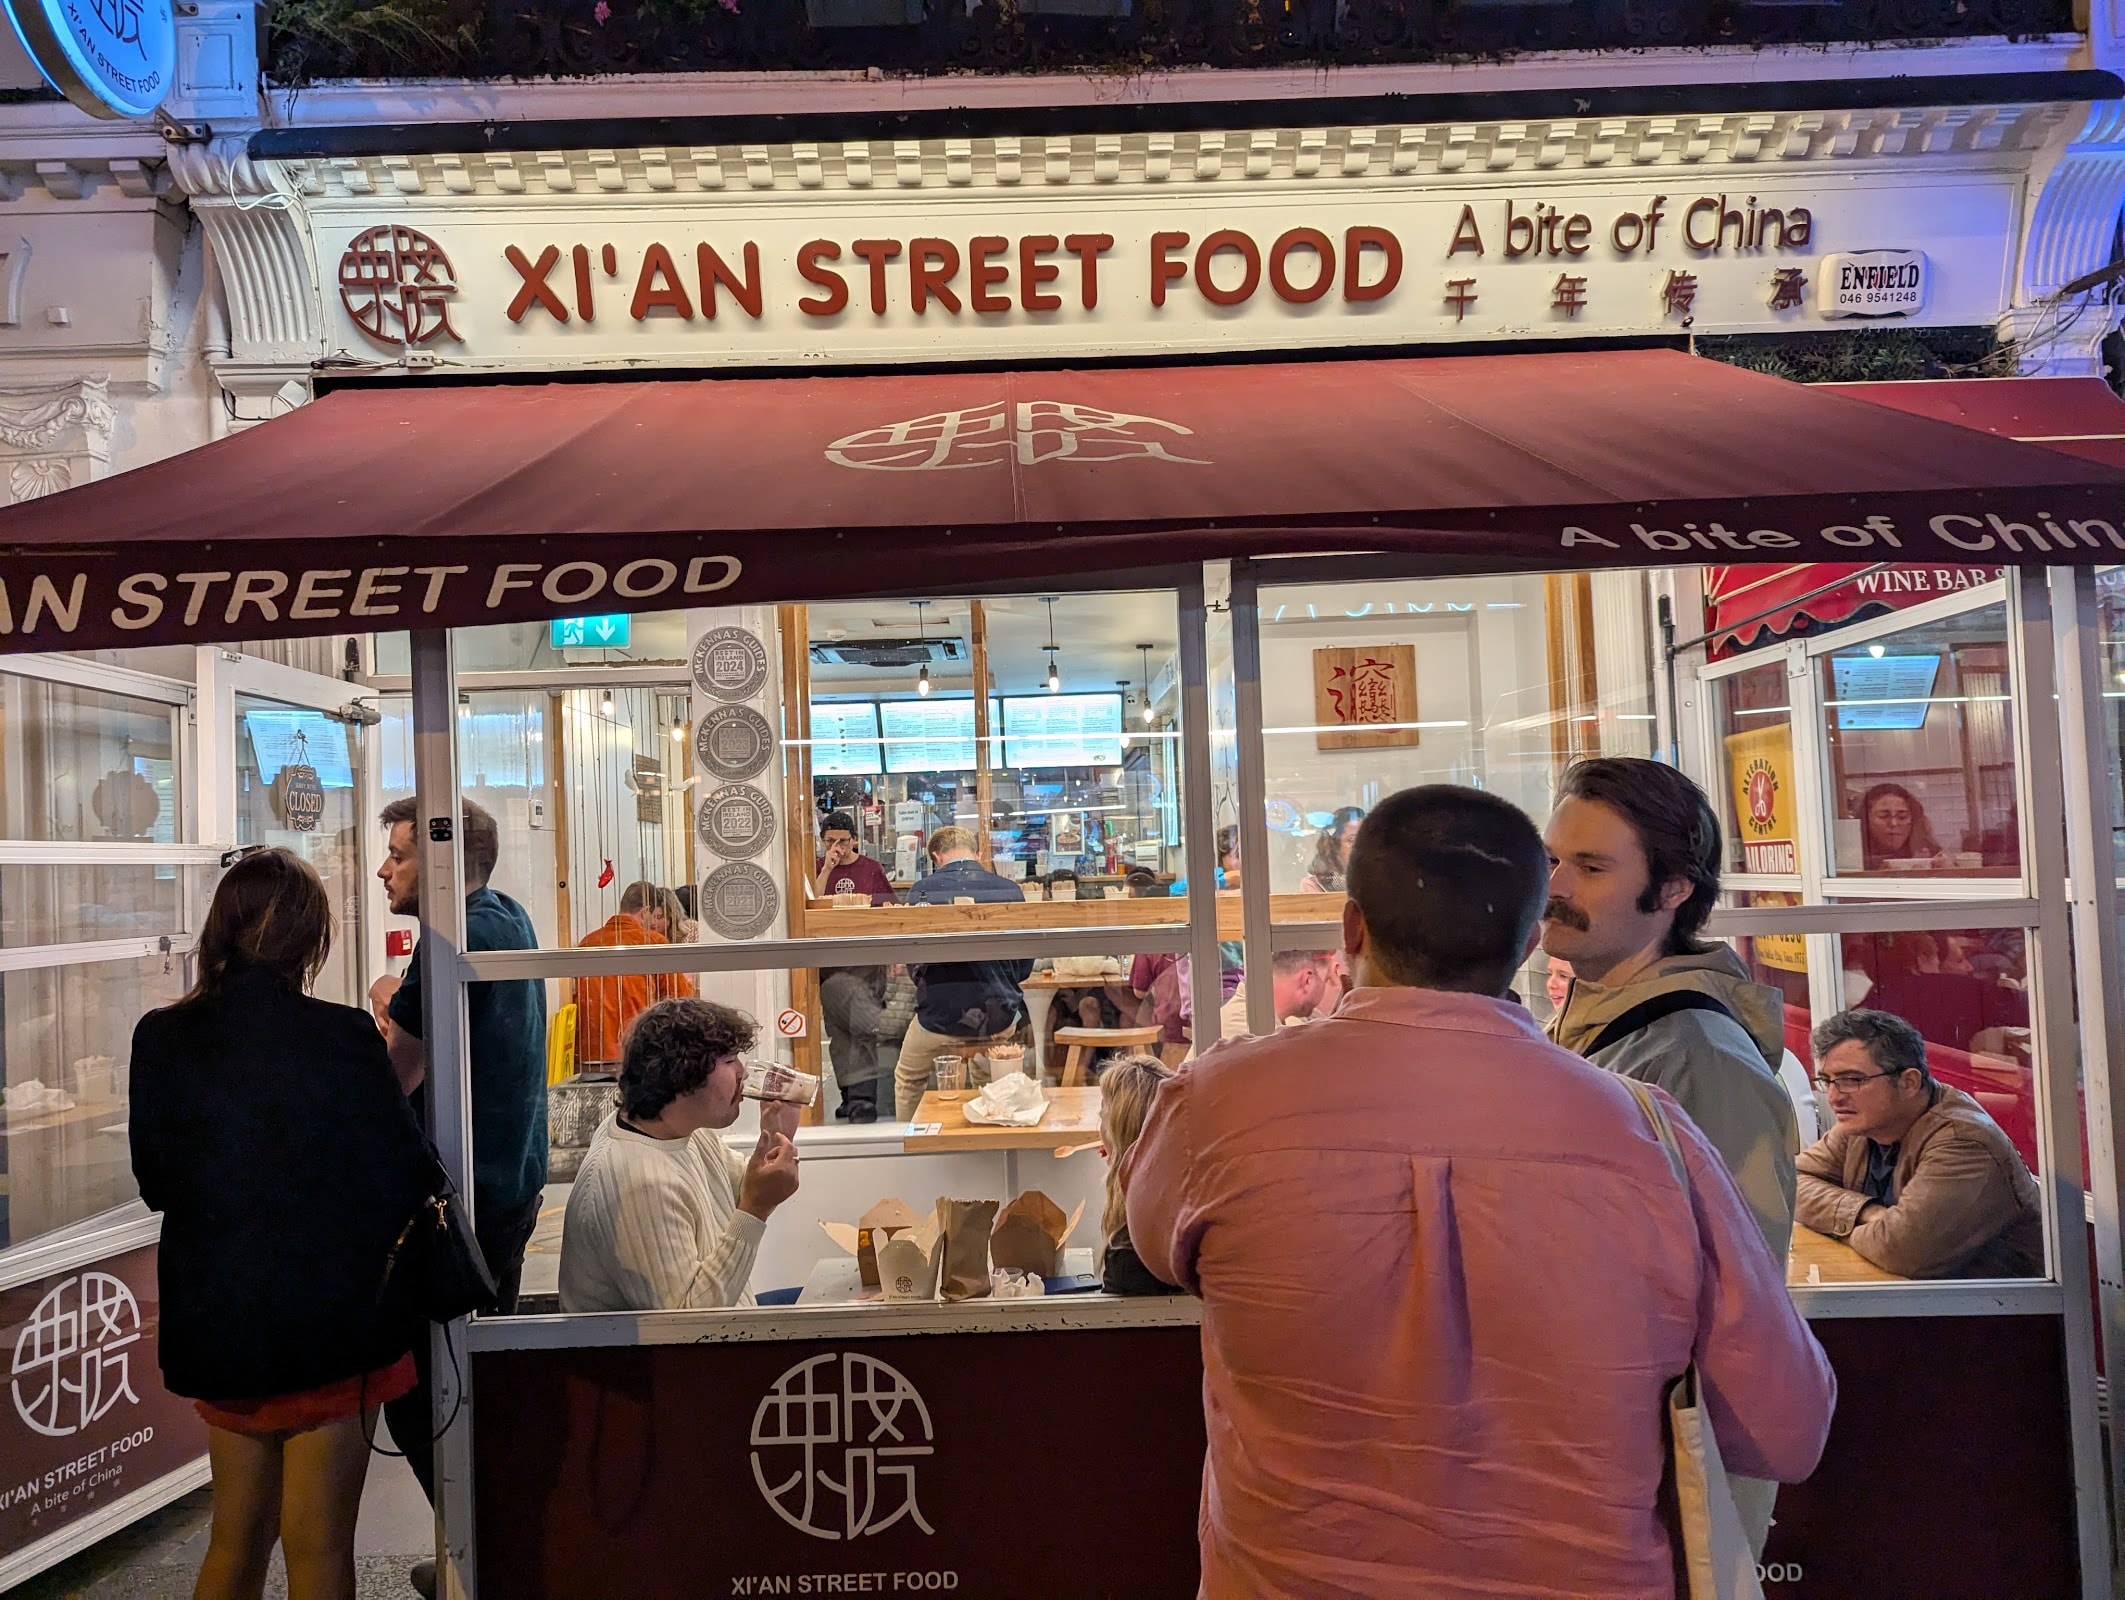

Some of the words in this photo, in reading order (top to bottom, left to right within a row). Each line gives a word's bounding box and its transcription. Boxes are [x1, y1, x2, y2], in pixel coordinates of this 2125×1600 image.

[67, 3, 96, 54] XI'AN
[97, 52, 138, 94] STREET
[138, 71, 161, 94] FOOD
[1446, 203, 1485, 258] A
[1502, 198, 1592, 257] bite
[1611, 195, 1668, 253] of
[1681, 193, 1814, 250] China
[504, 240, 764, 322] XI'AN
[796, 232, 1115, 317] STREET
[1150, 226, 1403, 308] FOOD
[1840, 264, 1920, 290] ENFIELD
[1840, 293, 1862, 304] 046
[1866, 291, 1917, 303] 9541248
[1559, 525, 1621, 550] A
[1629, 522, 1802, 552] bite
[1820, 515, 1904, 549] of
[111, 564, 469, 630] STREET
[486, 554, 744, 608] FOOD
[1856, 568, 1931, 594] WINE
[1933, 568, 1988, 591] BAR
[716, 660, 744, 672] 2024
[743, 633, 766, 673] GUIDES
[748, 714, 771, 751] GUIDES
[1742, 758, 1779, 795] ALTERATION
[289, 790, 322, 813] CLOSED
[750, 791, 773, 830] GUIDES
[723, 817, 751, 829] 2022
[1748, 813, 1777, 836] CENTRE
[753, 870, 776, 908] GUIDES
[43, 1446, 108, 1490] STREET
[110, 1426, 154, 1458] FOOD
[30, 1502, 41, 1517] A
[45, 1490, 69, 1510] bite
[73, 1479, 87, 1495] of
[89, 1464, 123, 1487] China
[731, 1574, 791, 1596] XI'AN
[797, 1572, 887, 1594] STREET
[893, 1570, 959, 1591] FOOD
